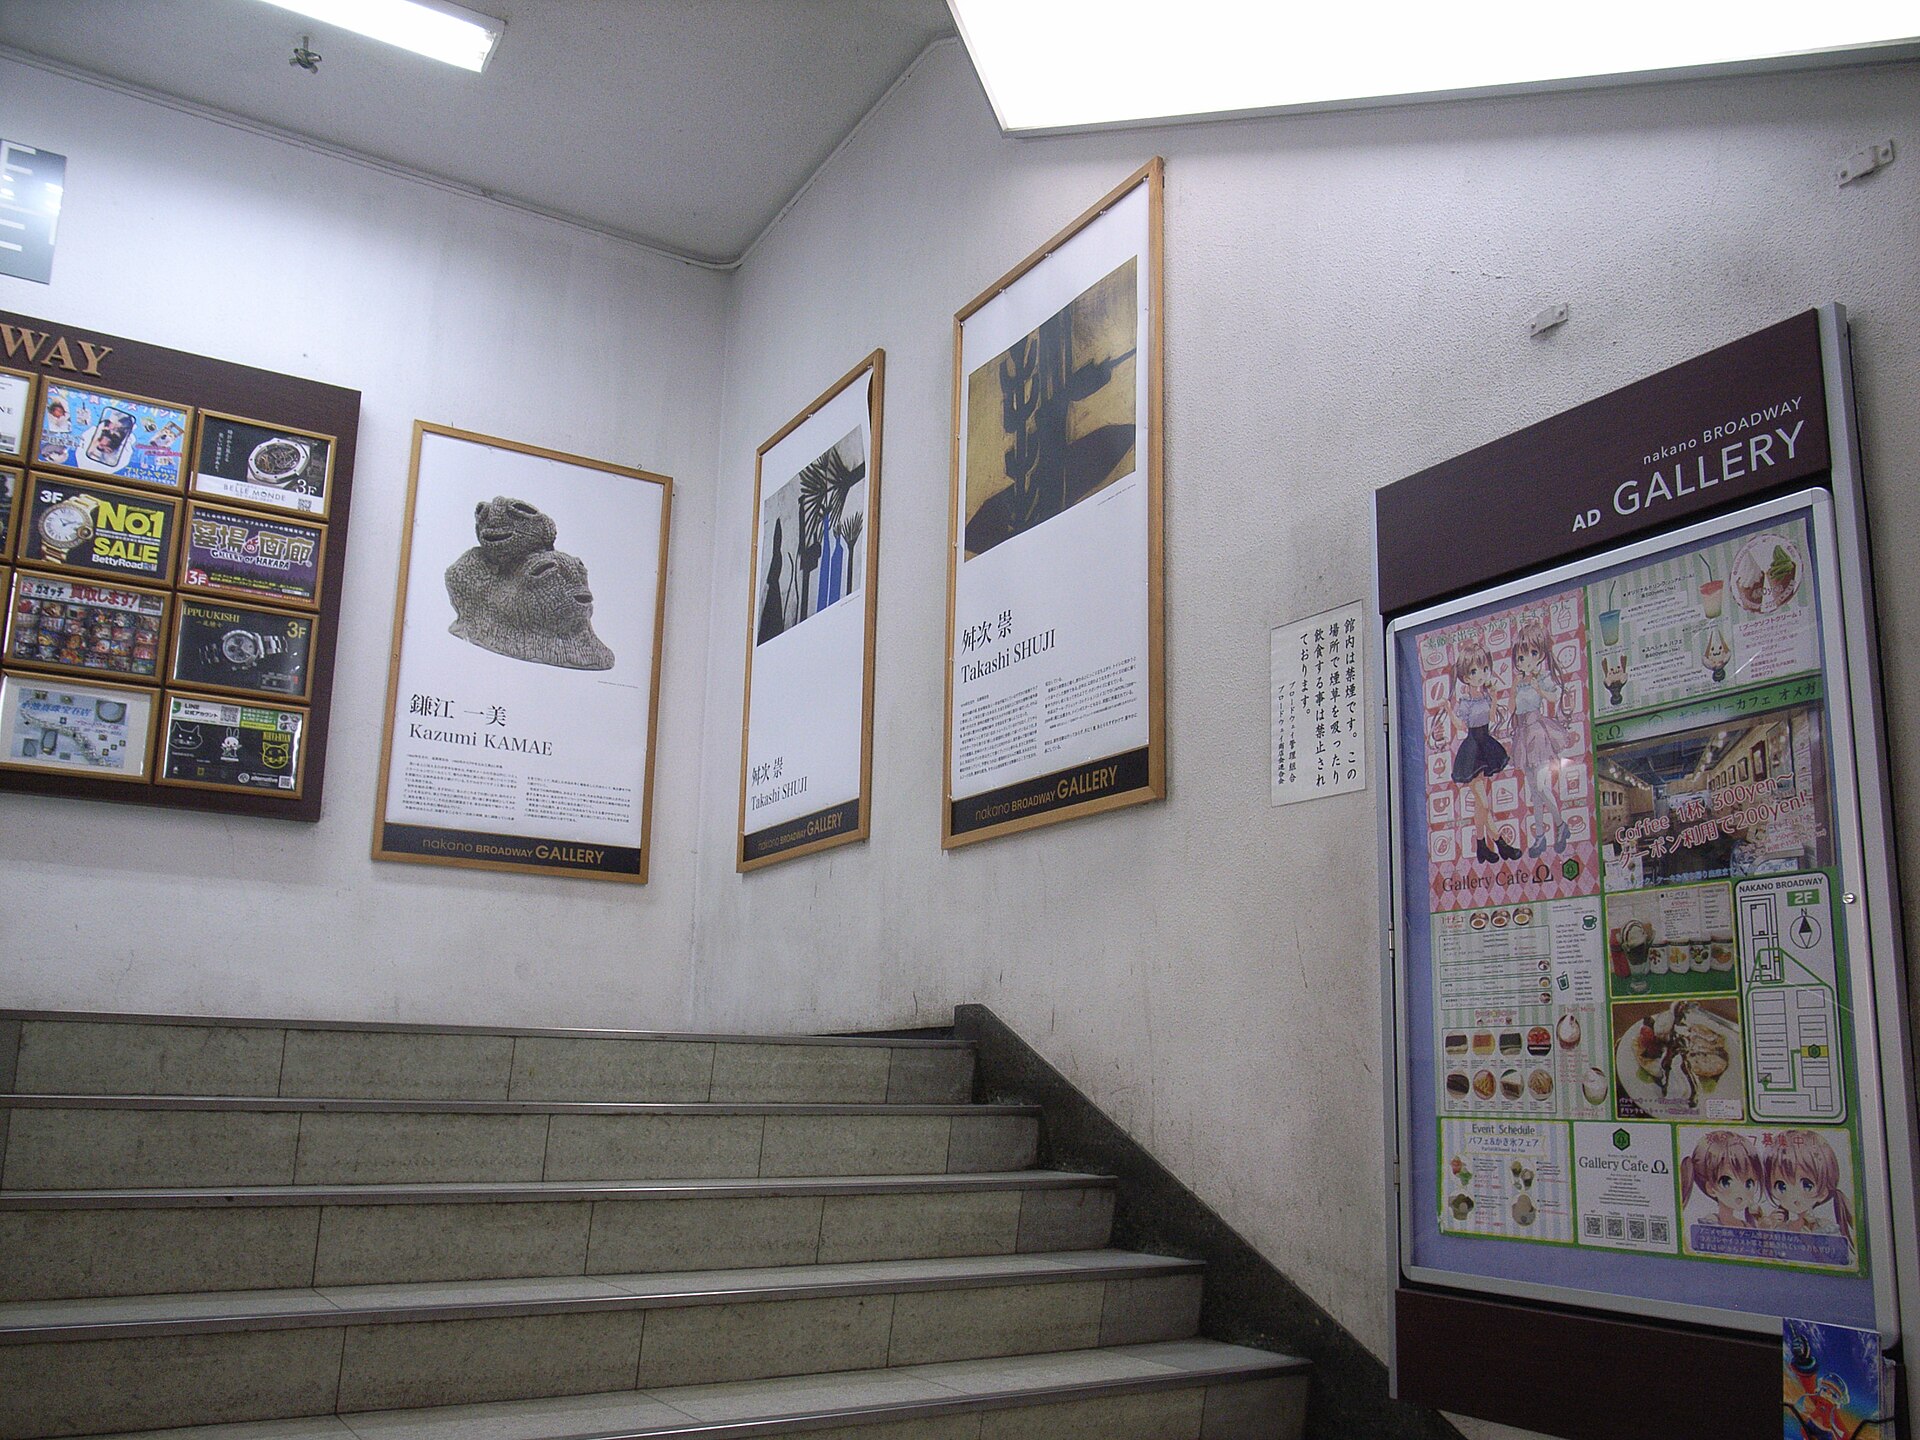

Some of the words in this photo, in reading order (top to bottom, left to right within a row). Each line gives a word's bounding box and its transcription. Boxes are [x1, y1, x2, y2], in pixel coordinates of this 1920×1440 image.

[1642, 437, 1697, 465] nakano
[1702, 395, 1803, 444] BROADWAY
[295, 478, 317, 497] 3F
[1571, 508, 1601, 533] AD
[1612, 419, 1805, 516] GALLERY
[39, 489, 64, 504] 3F
[92, 536, 161, 564] SALE
[191, 518, 315, 566] 墓場の画廊
[187, 569, 209, 586] 3F
[286, 620, 308, 640] 3F
[960, 646, 1011, 685] Takashi
[1012, 628, 1056, 664] SHUJI
[1299, 632, 1312, 715] ております。
[1328, 622, 1342, 786] 場所で煙草を吸ったり
[1778, 681, 1816, 702] オメガ
[463, 704, 508, 728] 一美
[1314, 628, 1327, 788] 飲食する事は禁止され
[408, 722, 478, 748] Kazumi
[484, 733, 554, 757] KAMAE
[750, 784, 781, 812] Takashi
[781, 774, 809, 800] SHUJI
[974, 801, 1011, 823] nakano
[1010, 790, 1057, 812] BROADWAY
[1056, 764, 1119, 800] GALLERY
[806, 810, 844, 838] GALLERY
[1615, 814, 1671, 845] Coffee
[1676, 798, 1706, 823] 1杯
[422, 837, 474, 853] nakano
[475, 843, 534, 859] BROADWAY
[535, 844, 605, 865] GALLERY
[1442, 870, 1494, 894] Gallery
[1495, 865, 1530, 888] Cafe
[1738, 881, 1774, 894] NAKANO
[1775, 876, 1824, 892] BROADWAY
[1793, 892, 1814, 904] 2F
[1800, 908, 1808, 916] N
[1471, 1123, 1495, 1136] Event
[1498, 1124, 1536, 1136] Schedule
[1578, 1156, 1620, 1172] Gallery
[1621, 1158, 1649, 1173] Cafe
